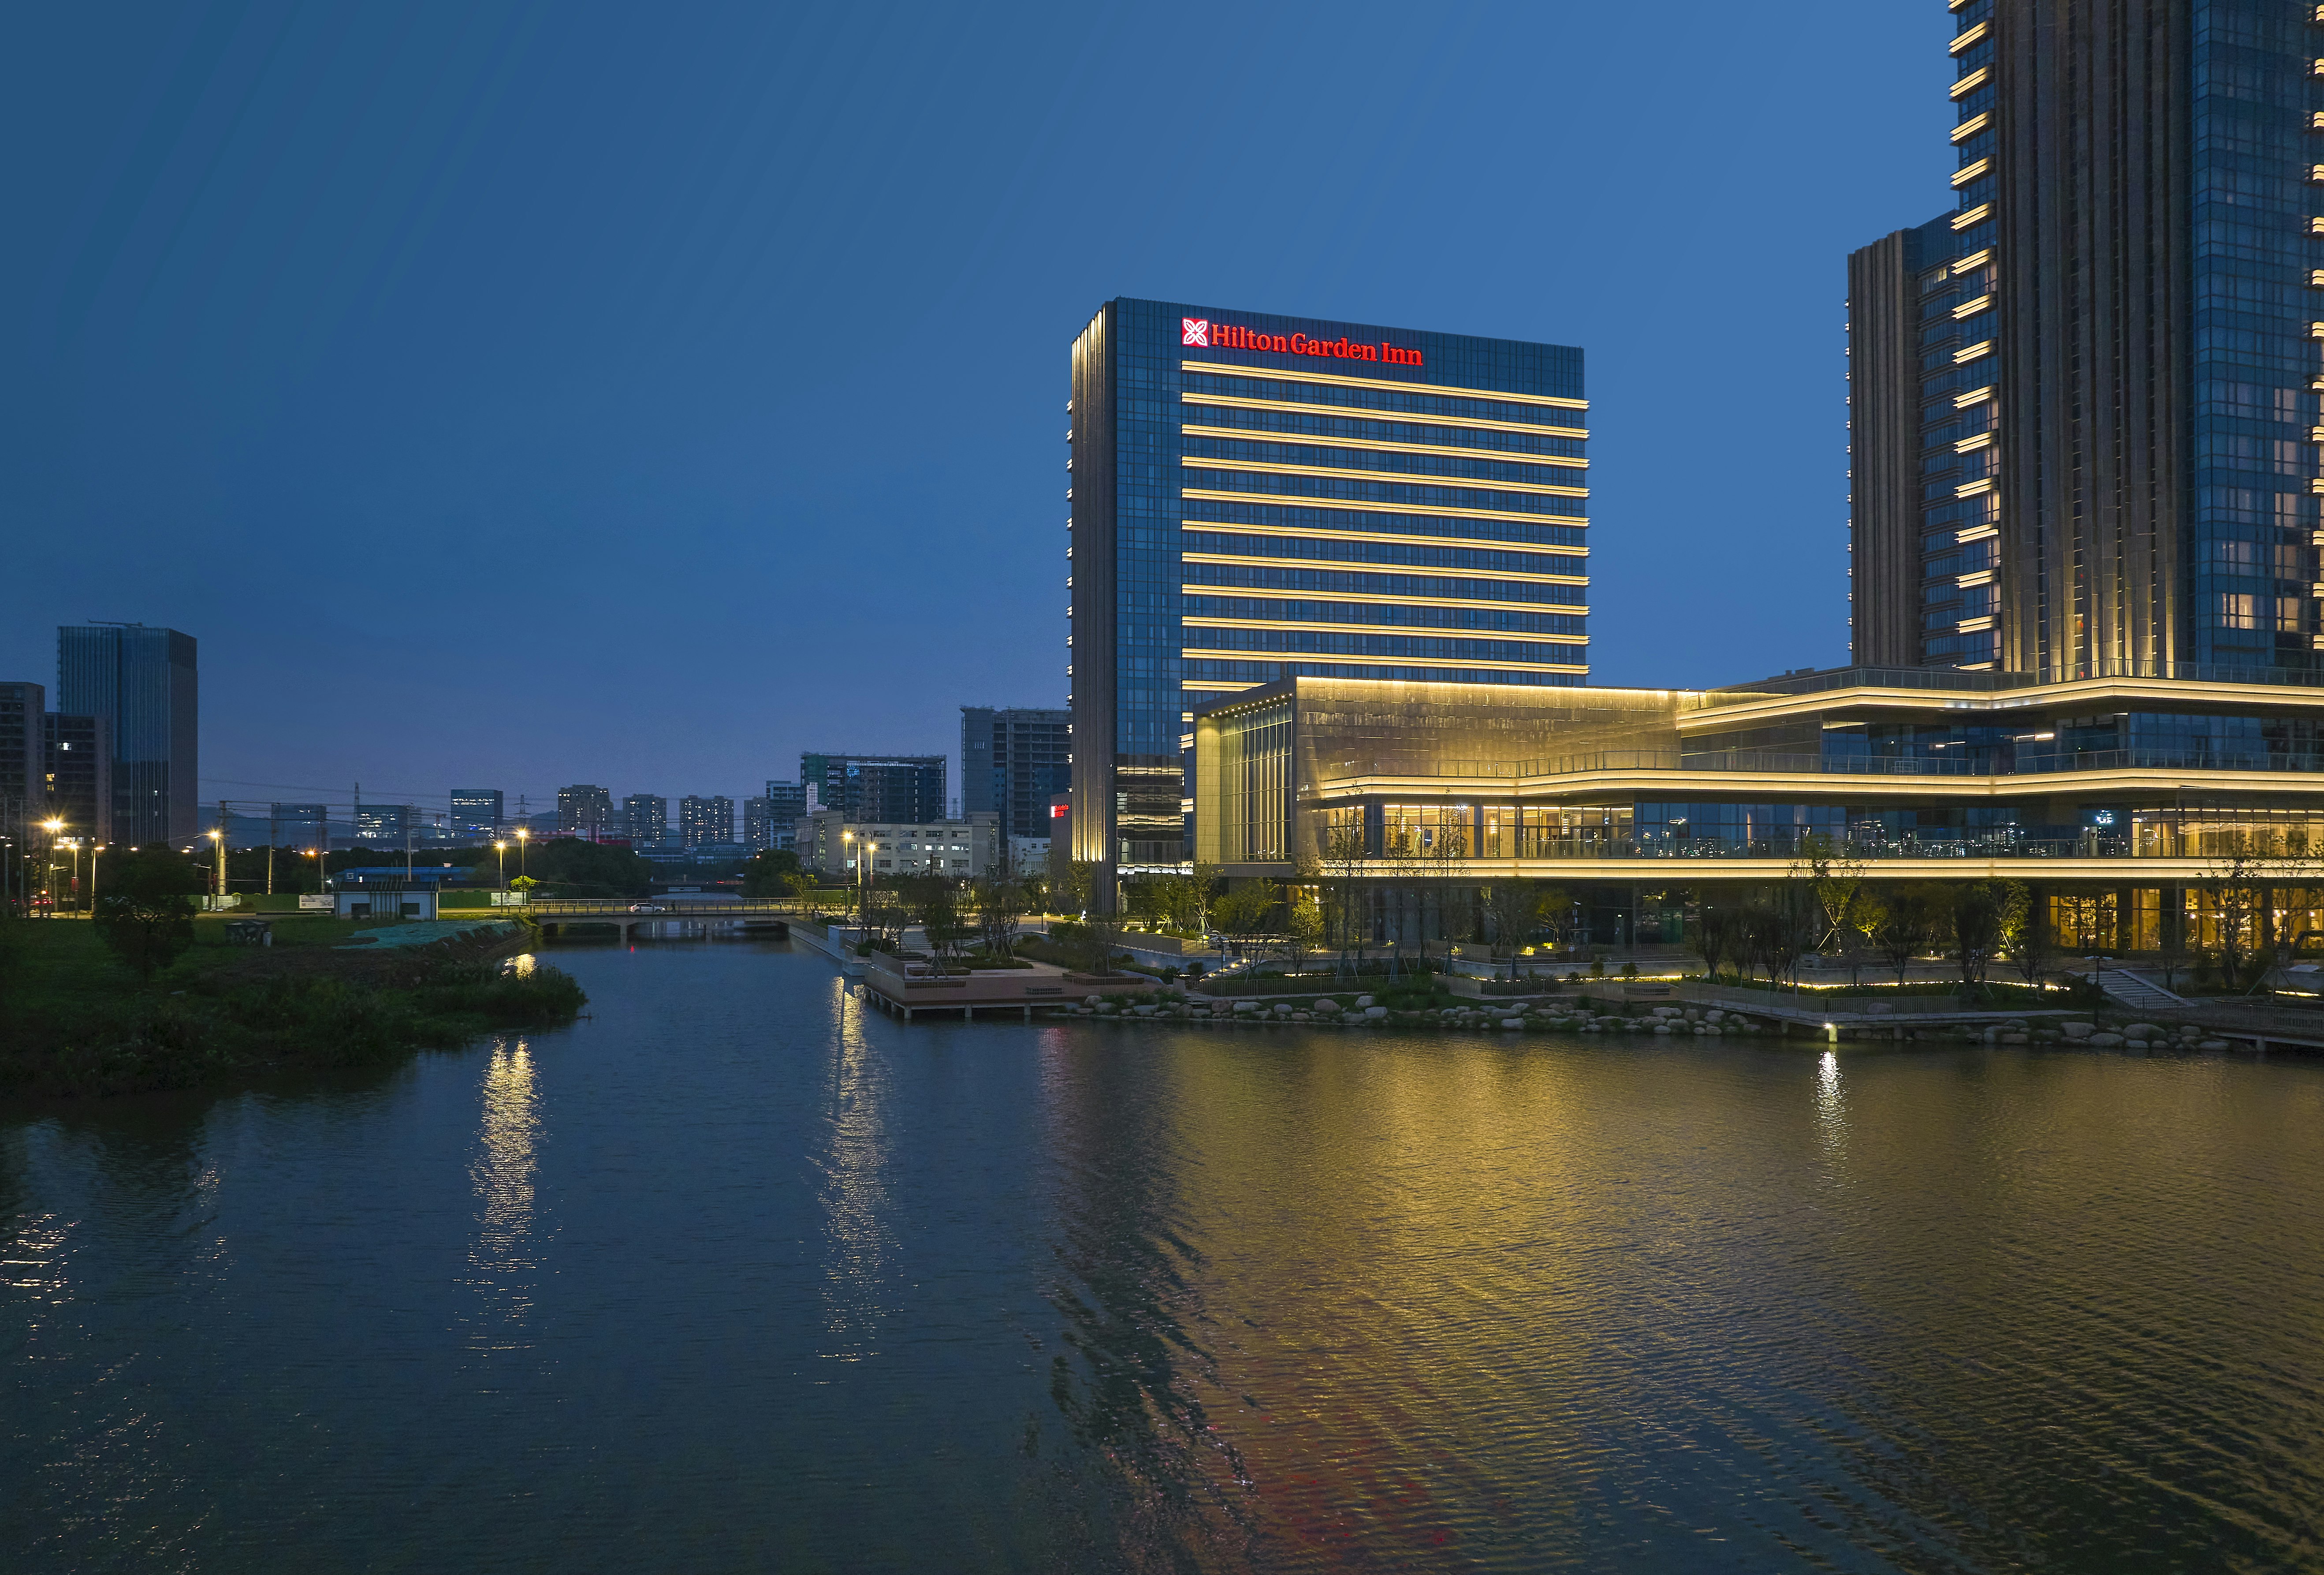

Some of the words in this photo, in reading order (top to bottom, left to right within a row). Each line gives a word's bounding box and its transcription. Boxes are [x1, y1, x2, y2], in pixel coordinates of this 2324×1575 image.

[1211, 324, 1287, 352] Hilton
[1290, 333, 1377, 361] Garden
[1381, 342, 1423, 366] Inn
